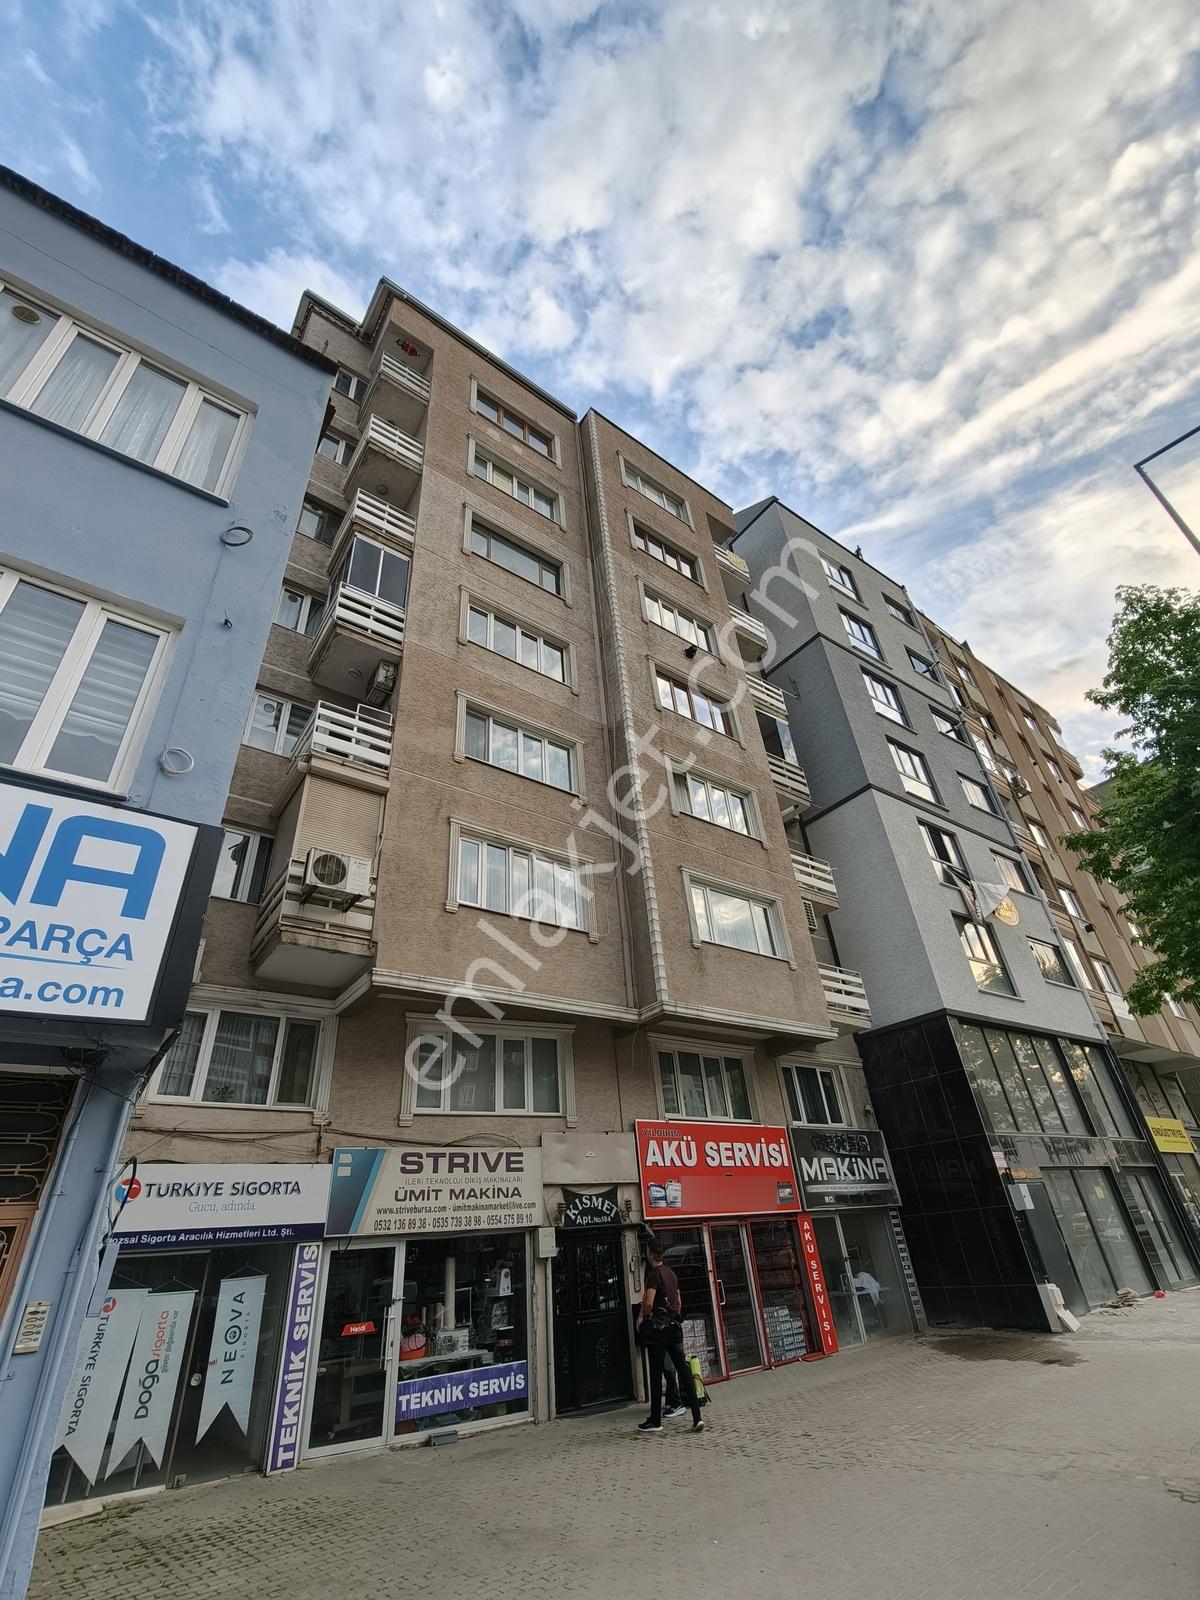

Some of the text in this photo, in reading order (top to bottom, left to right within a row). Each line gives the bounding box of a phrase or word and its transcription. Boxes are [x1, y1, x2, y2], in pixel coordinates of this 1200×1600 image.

[400, 1151, 524, 1174] STRIVE
[646, 1136, 697, 1167] AKÜ
[705, 1137, 790, 1168] SERVİSİ
[145, 1181, 302, 1198] TÜRKİYE SİGORTA
[394, 1185, 523, 1202] ÜMİT MAKİNA
[221, 1200, 256, 1211] adında
[376, 1204, 447, 1215] www.strivebursa.com
[566, 1195, 619, 1220] KISMET
[373, 1219, 391, 1231] 0532
[394, 1219, 406, 1230] 136
[432, 1216, 449, 1228] 0535
[451, 1216, 463, 1227] 739
[474, 1215, 482, 1226] 98
[486, 1214, 502, 1225] 0554
[503, 1213, 515, 1224] 575
[526, 1212, 533, 1223] 10
[140, 1234, 177, 1245] Sigorta
[177, 1231, 214, 1242] Aracılık
[216, 1229, 261, 1240] Hizmetleri
[262, 1228, 279, 1237] Ltd.
[280, 1227, 295, 1238] Şti.
[803, 1221, 833, 1346] AKÜ SERVİSİ
[220, 1291, 246, 1385] NEOVA
[277, 1244, 318, 1468] TEKNİK SERVİS
[398, 1372, 526, 1411] TEKNİK SERVİS
